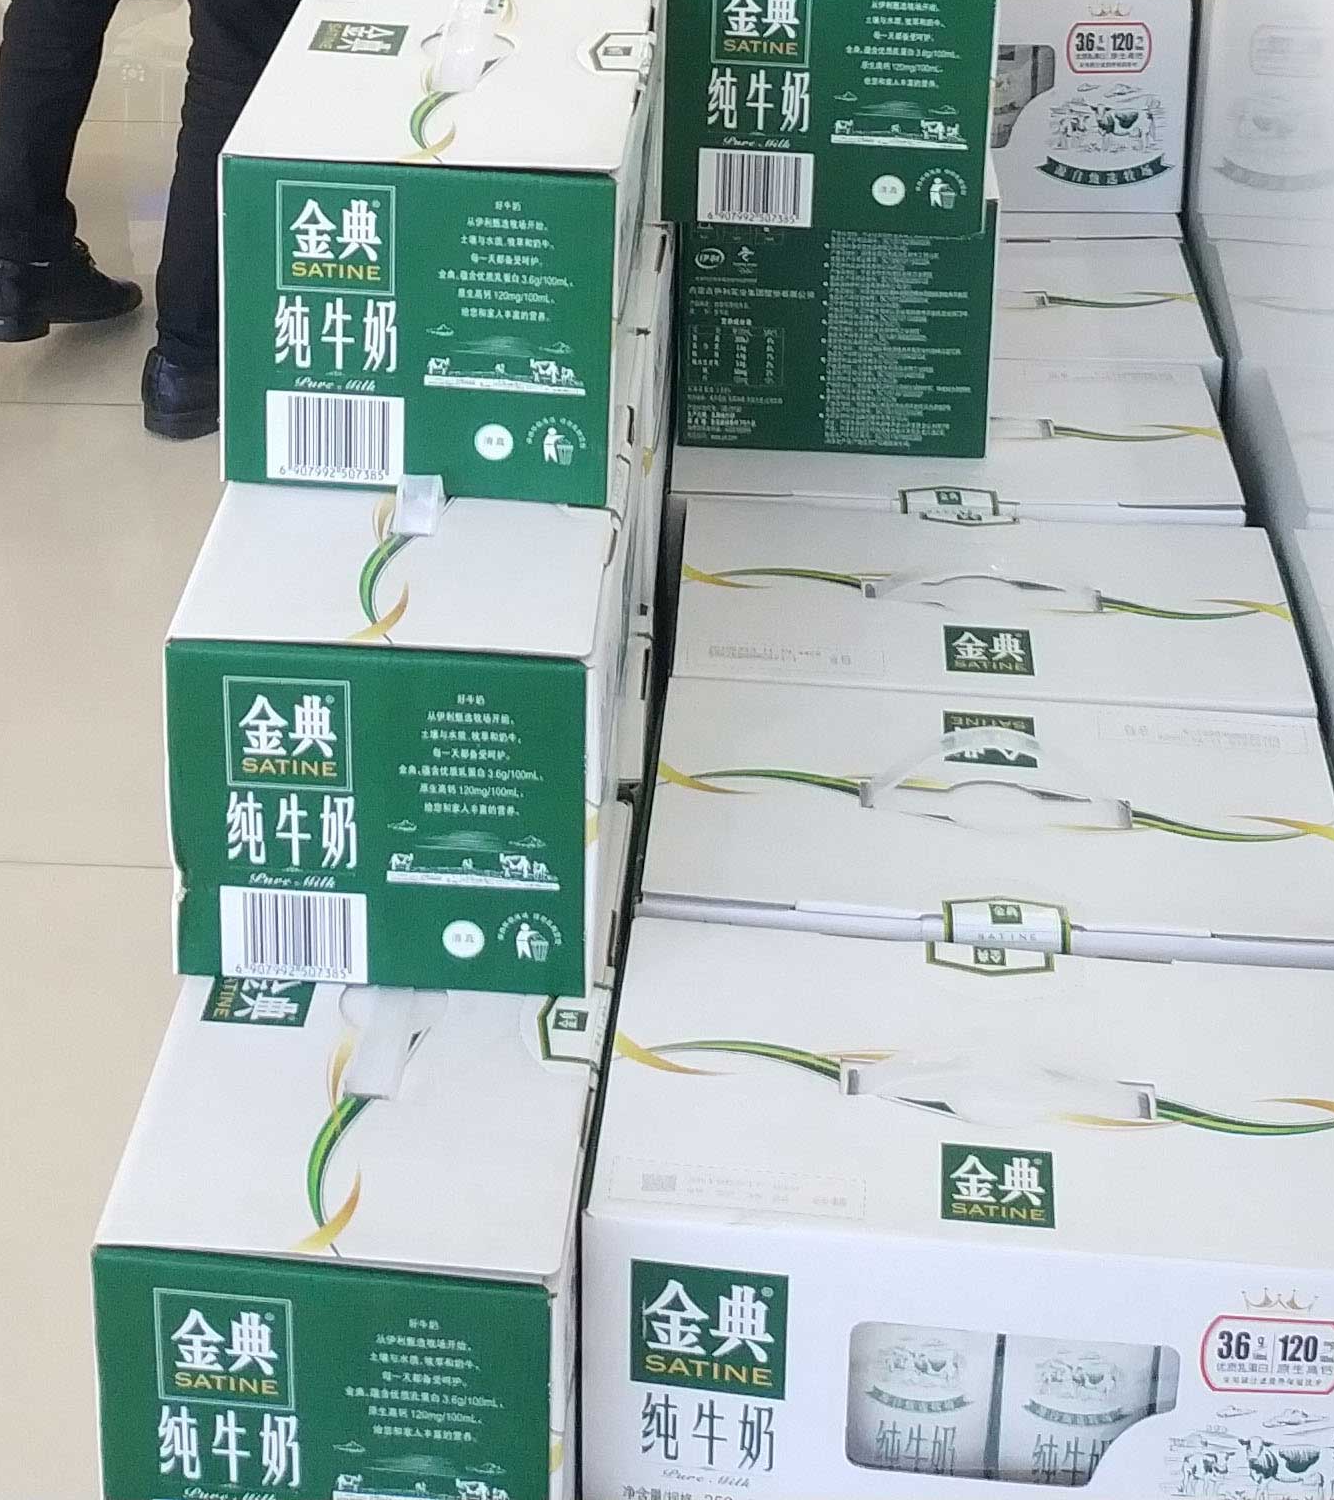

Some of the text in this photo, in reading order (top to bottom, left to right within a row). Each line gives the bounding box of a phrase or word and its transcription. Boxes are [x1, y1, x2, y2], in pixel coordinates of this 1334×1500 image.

[336, 23, 395, 54] 金典
[723, 39, 798, 56] SATINE
[1111, 32, 1134, 51] 120
[707, 67, 810, 132] 纯牛奶
[289, 199, 382, 262] 金典
[292, 262, 381, 281] SATINE
[275, 295, 397, 373] 纯牛奶
[952, 631, 1027, 663] 金典
[238, 694, 338, 758] 金典
[242, 758, 338, 777] SATINE
[226, 790, 358, 869] 纯牛奶
[249, 963, 296, 977] 907992
[301, 965, 348, 980] 507385
[949, 1154, 1046, 1206] 金典
[951, 1202, 1046, 1221] SATINE
[641, 1279, 775, 1363] 金典
[171, 1308, 279, 1376] 金典
[1217, 1330, 1252, 1360] 3.6
[1278, 1335, 1319, 1363] 120
[174, 1371, 280, 1396] SATINE
[644, 1354, 774, 1387] SATINE
[157, 1404, 302, 1489] 纯牛奶
[640, 1391, 775, 1472] 纯牛奶
